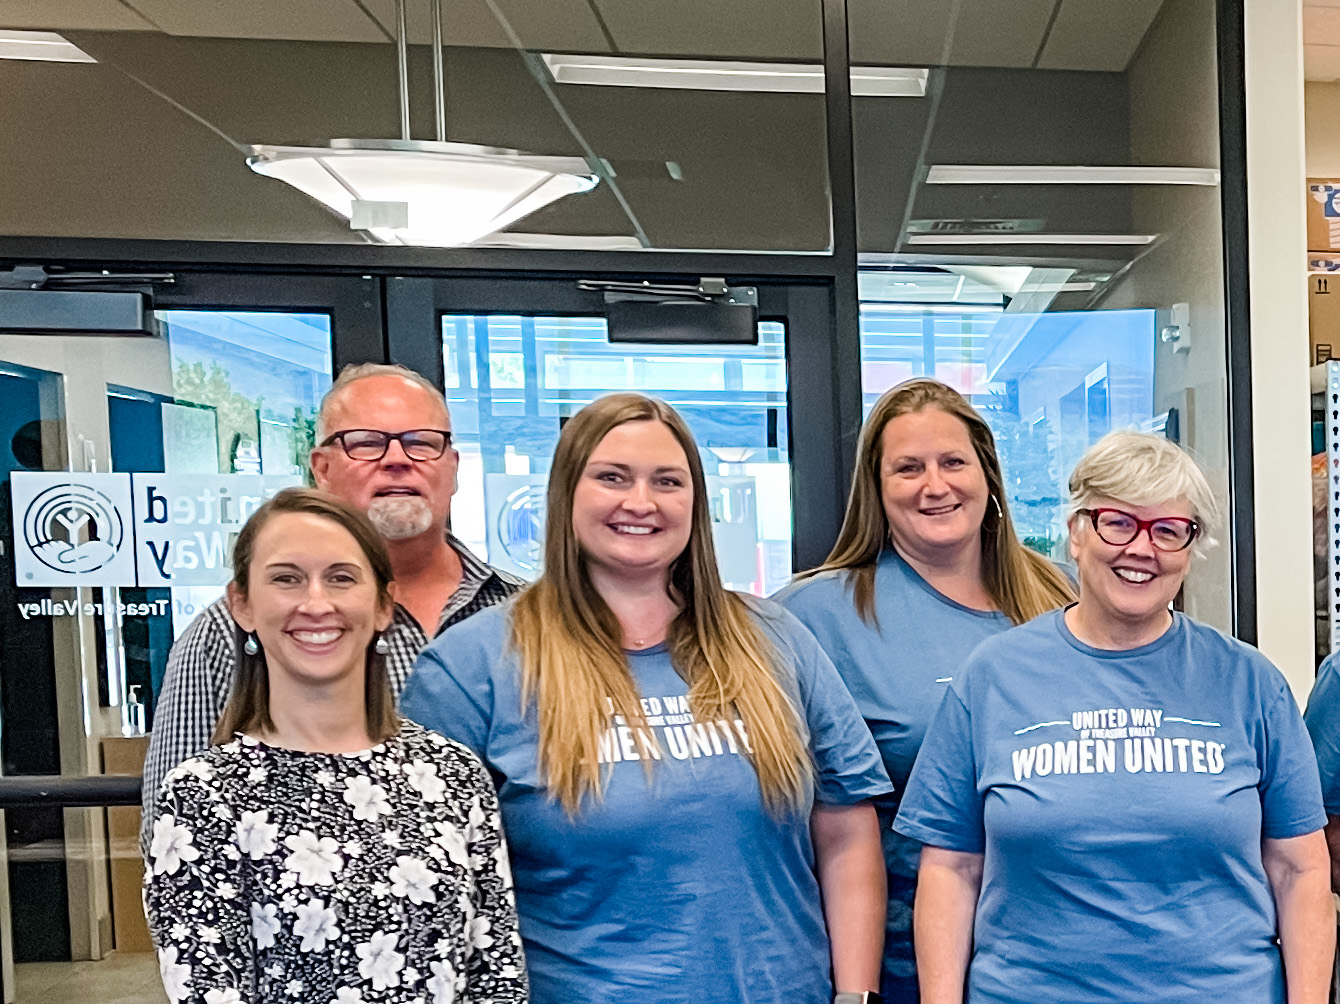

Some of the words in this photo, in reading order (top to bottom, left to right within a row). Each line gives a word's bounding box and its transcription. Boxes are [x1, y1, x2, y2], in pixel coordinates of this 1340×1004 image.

[1072, 709, 1128, 731] UNITED
[1130, 708, 1163, 728] WAY
[1012, 740, 1116, 781] WOMEN
[1124, 739, 1225, 774] UNITED
